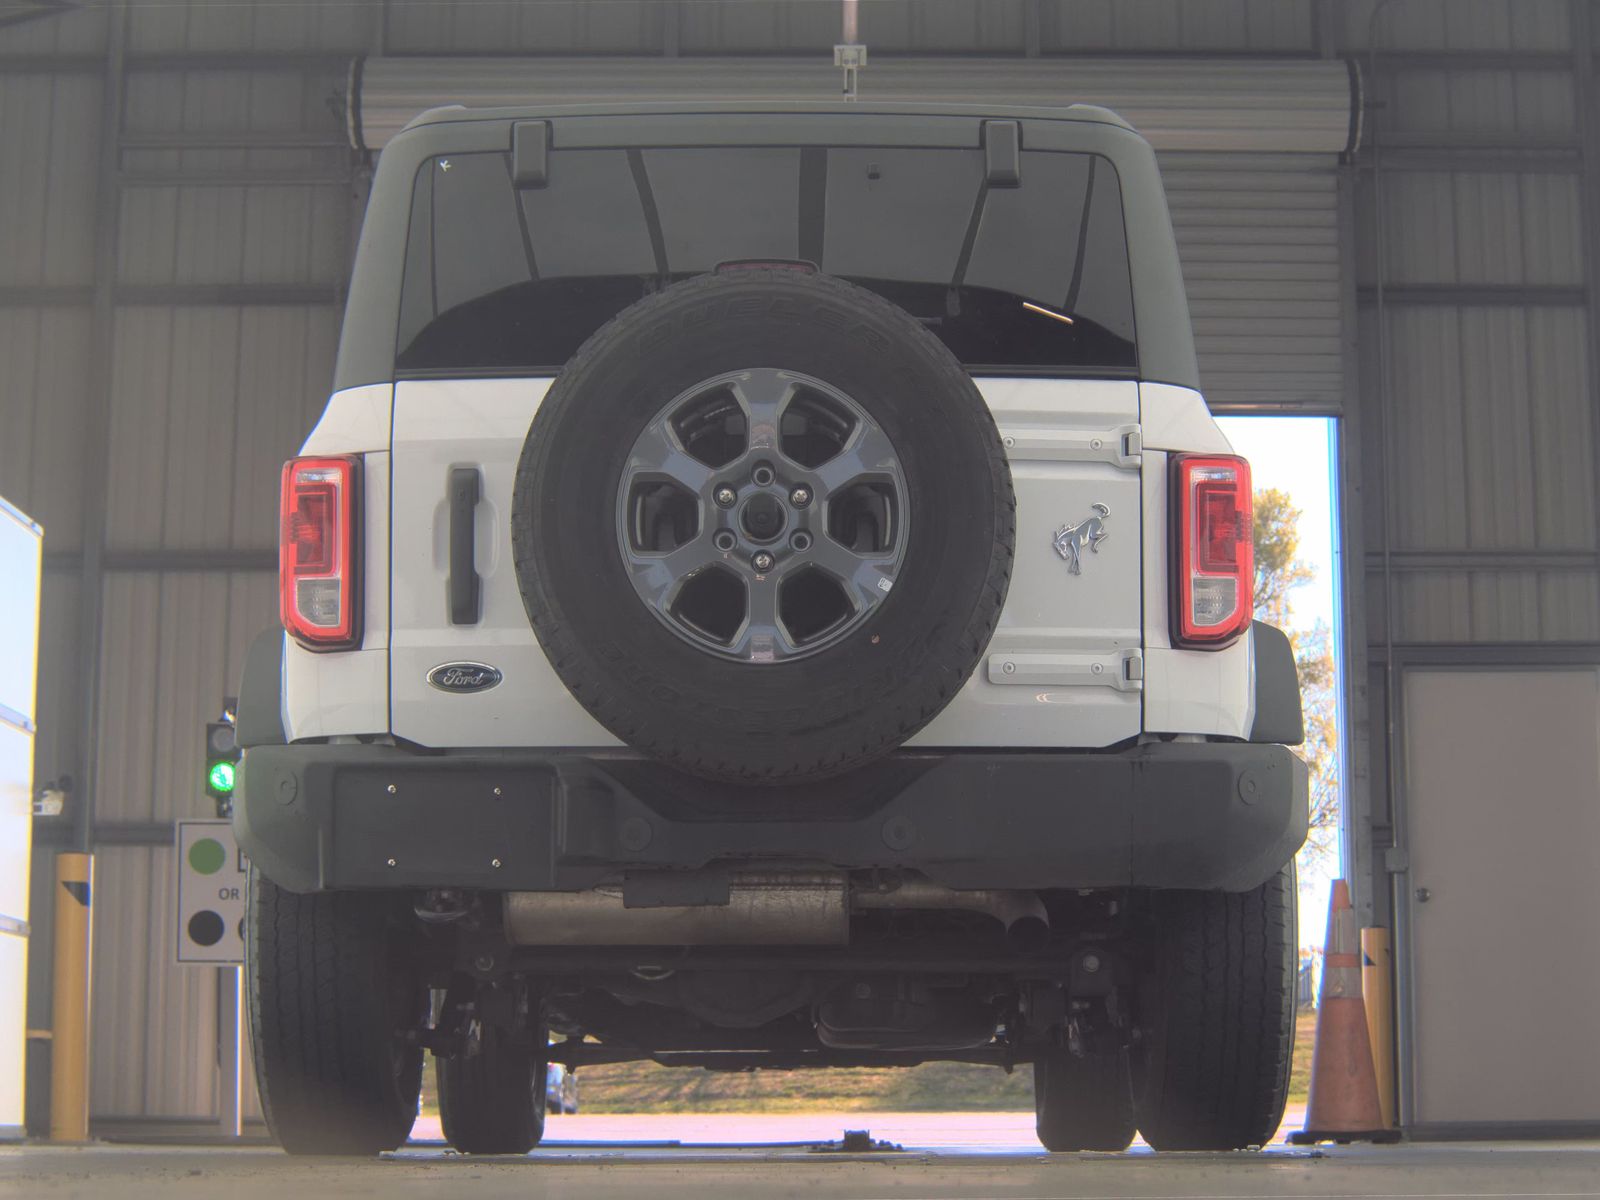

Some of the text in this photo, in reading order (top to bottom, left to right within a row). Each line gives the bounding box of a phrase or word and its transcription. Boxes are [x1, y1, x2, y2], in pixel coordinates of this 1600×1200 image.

[636, 296, 893, 356] DUELER
[442, 666, 485, 686] Ford
[218, 887, 240, 901] OR
